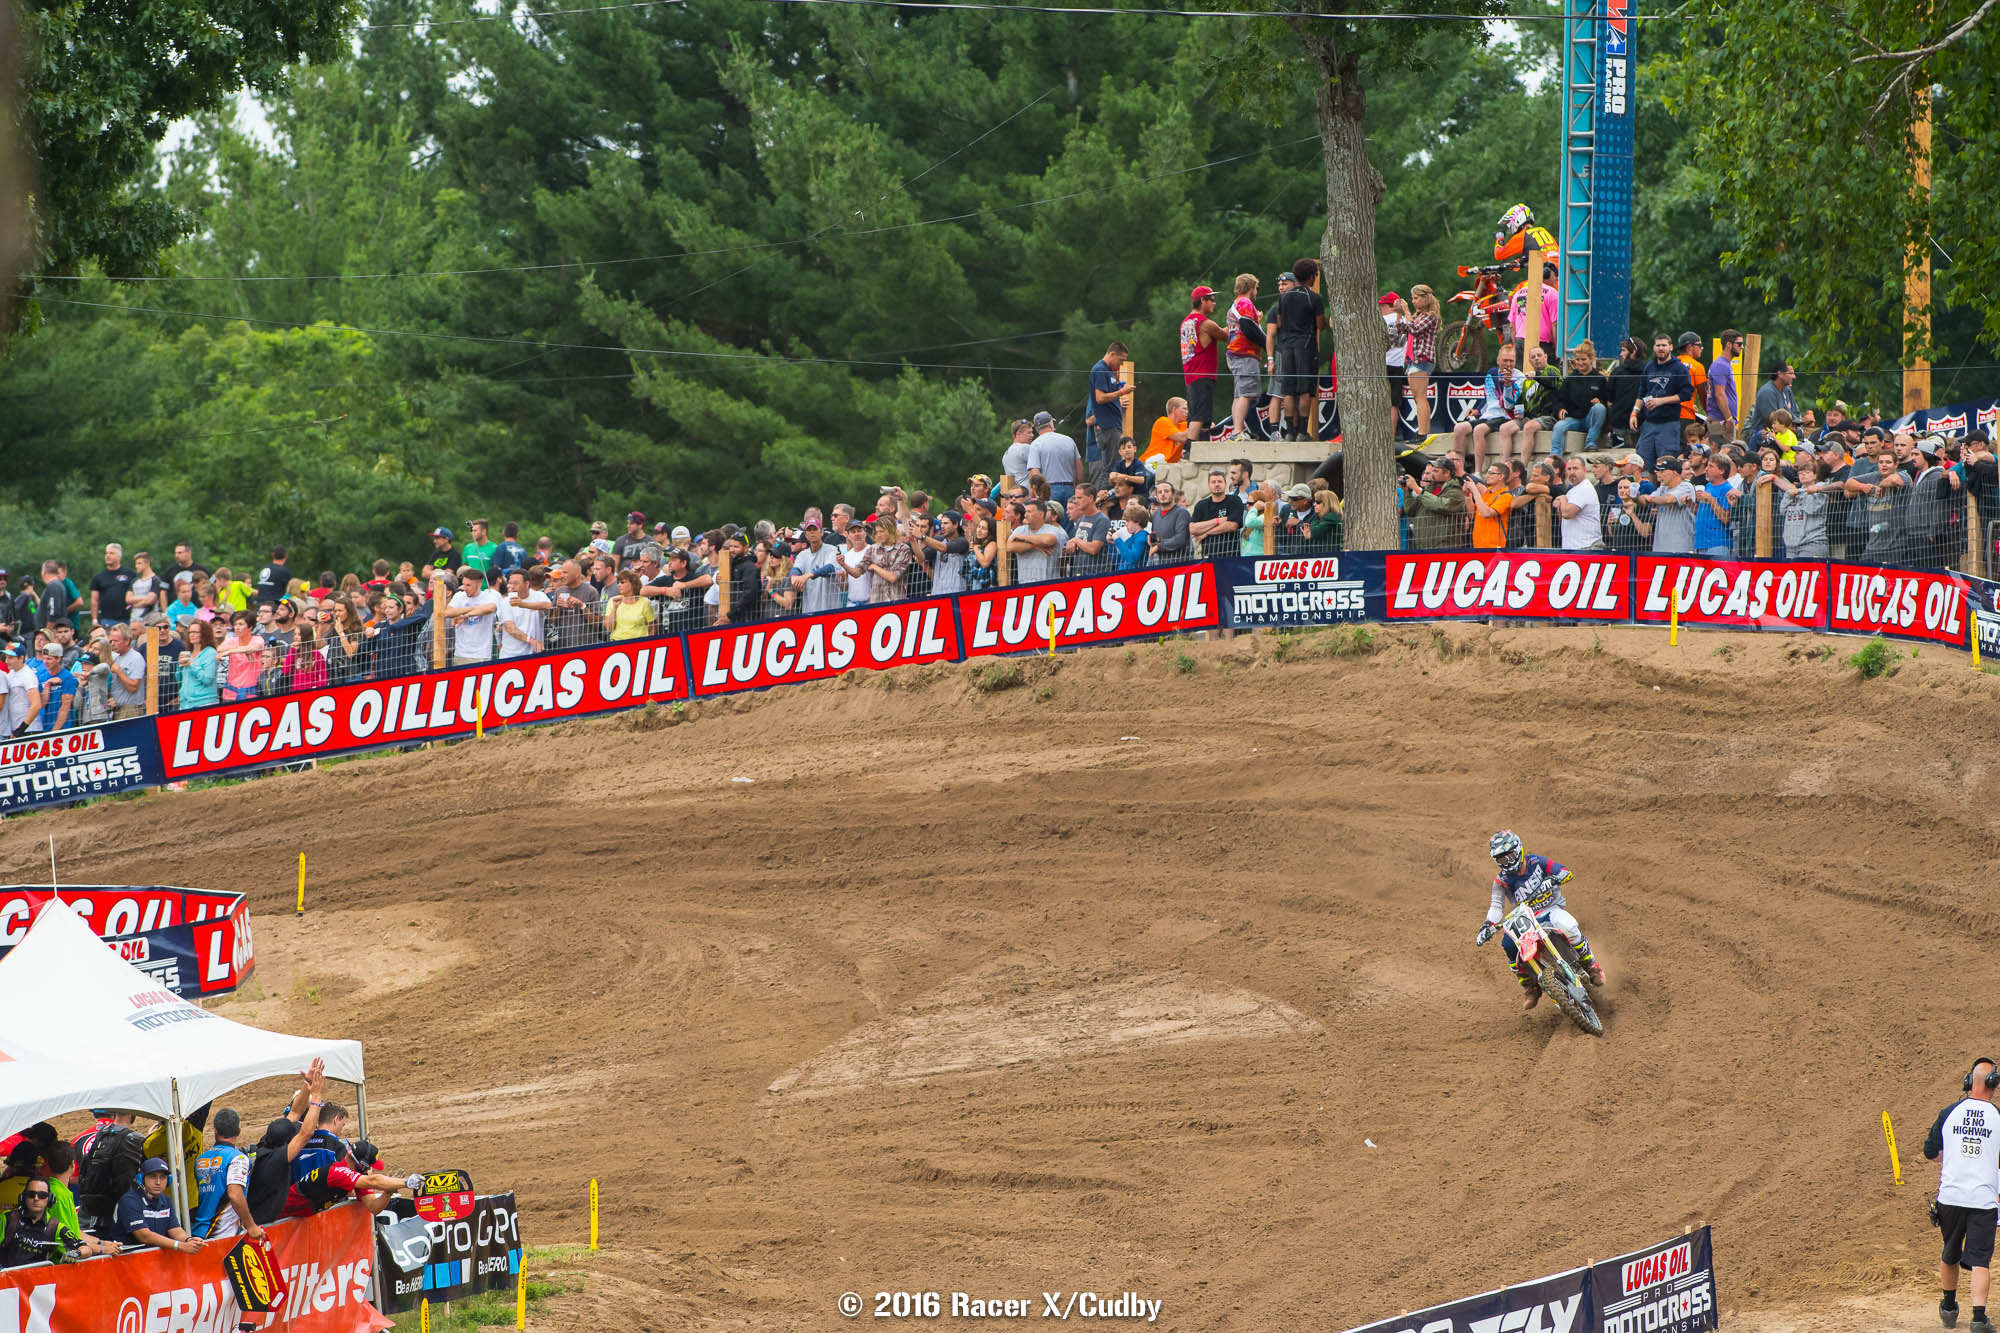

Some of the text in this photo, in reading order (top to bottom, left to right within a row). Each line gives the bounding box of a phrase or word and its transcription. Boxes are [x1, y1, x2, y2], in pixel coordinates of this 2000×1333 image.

[1604, 58, 1613, 113] RACING
[1611, 58, 1626, 114] PRO
[1929, 420, 1964, 431] RACER
[1258, 559, 1335, 581] LUCAS OIL
[1279, 582, 1317, 591] PRO
[1393, 559, 1542, 610] LUCAS
[1548, 560, 1620, 611] OIL
[1233, 589, 1366, 615] MOTOCROSS
[1643, 564, 1775, 620] LUCAS
[1775, 569, 1821, 619] OIL
[1835, 572, 1962, 635] LUCAS OIL
[972, 571, 1208, 649] LUCAS OIL
[1233, 610, 1366, 624] CHAMPIONSHIP
[701, 607, 946, 687] LUCAS OIL
[429, 646, 676, 729] LUCAS OIL
[0, 731, 100, 766] LUCAS OIL
[172, 695, 337, 769] LUCAS
[0, 754, 142, 798] OTOCROSS
[28, 757, 76, 772] PRO
[1, 774, 144, 807] AMPIONSHIP
[1962, 1117, 1985, 1127] IS NO
[1966, 1109, 1985, 1118] THIS
[1952, 1126, 1993, 1139] HIGHWAY
[1962, 1144, 1981, 1155] 338
[1626, 1245, 1689, 1292] LUCAS OIL
[395, 1280, 406, 1295] Be
[405, 1282, 410, 1294] a
[1643, 1283, 1673, 1303] PRO
[1603, 1282, 1711, 1333] MOTOCROSS
